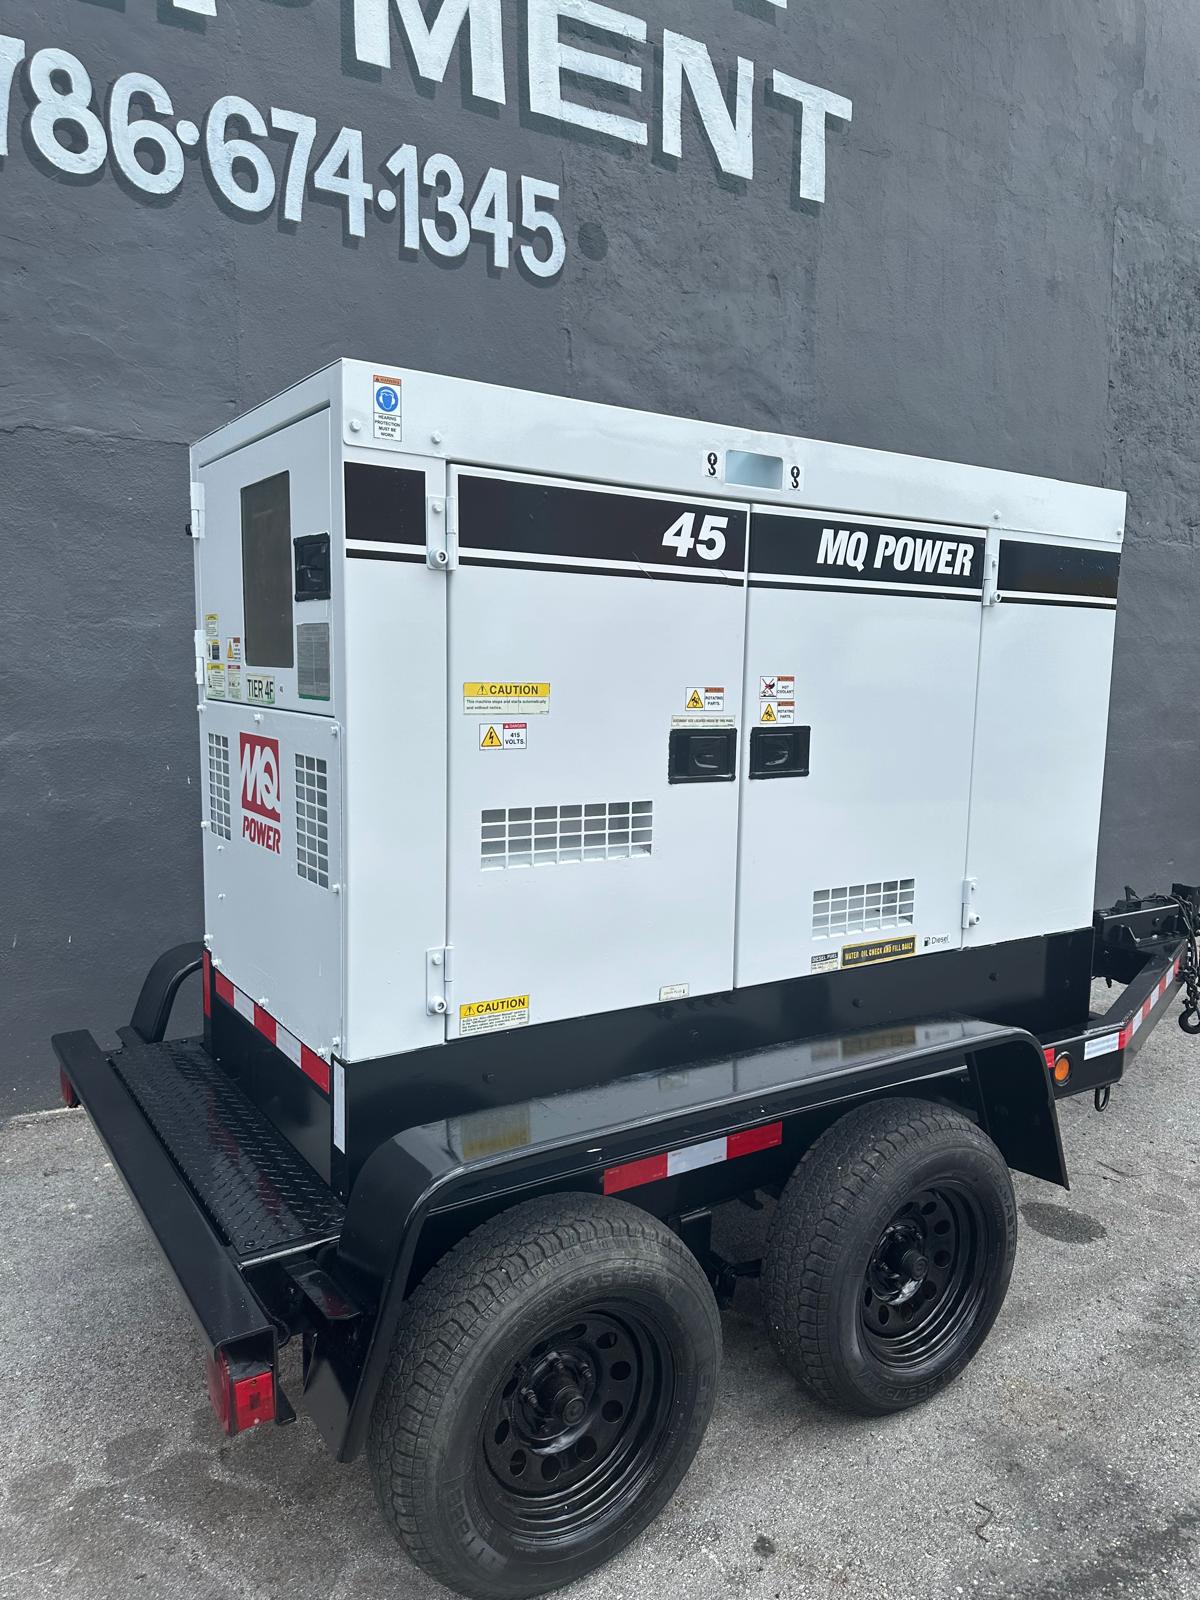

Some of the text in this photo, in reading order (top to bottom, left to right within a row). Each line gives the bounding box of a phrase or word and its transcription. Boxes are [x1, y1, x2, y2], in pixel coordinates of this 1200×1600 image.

[375, 419, 400, 427] PROTECTION
[662, 511, 728, 561] 45
[816, 528, 974, 576] MQ POWER
[247, 679, 263, 698] TIER
[264, 680, 274, 699] 4F
[489, 685, 539, 695] CAUTION
[241, 743, 280, 814] MQ
[242, 815, 281, 854] POWER
[931, 935, 949, 945] Diesel
[844, 942, 913, 960] WATER OIL CHECK AND FILL DAILY
[476, 997, 525, 1013] CAUTION
